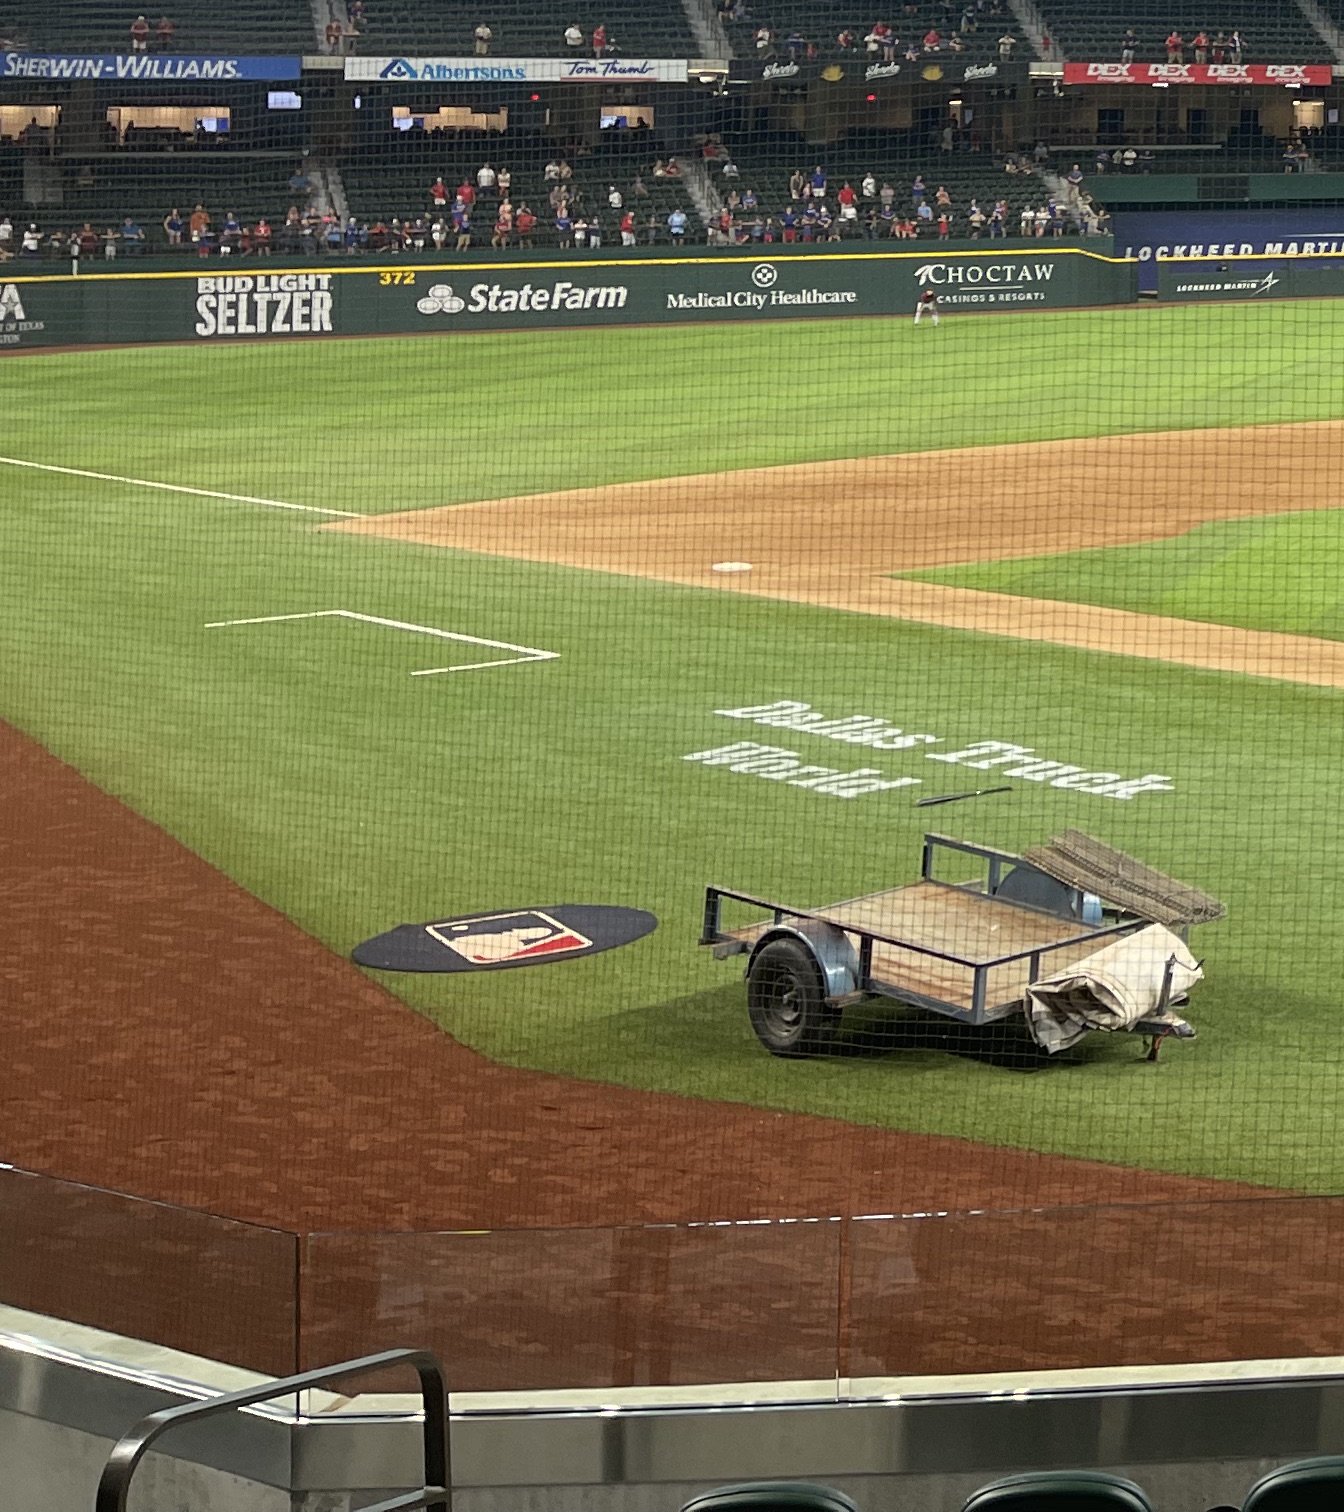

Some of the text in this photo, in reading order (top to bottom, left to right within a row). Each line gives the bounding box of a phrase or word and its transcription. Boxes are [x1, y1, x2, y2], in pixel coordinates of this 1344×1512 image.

[421, 59, 655, 81] Albertsons Tom Thumb
[1087, 63, 1132, 77] DEX
[1148, 63, 1192, 77] DEX
[1207, 64, 1250, 78] DEX
[1265, 64, 1307, 78] DEX
[198, 273, 331, 294] BUD LIGHT
[379, 271, 416, 285] 372
[927, 263, 1054, 284] CHOCTAW
[667, 289, 857, 310] Medical City Healthcare
[999, 291, 1045, 303] RESORTS
[195, 291, 333, 337] SELTZER
[713, 700, 1175, 799] Dallas Truck
[681, 741, 922, 798] World
